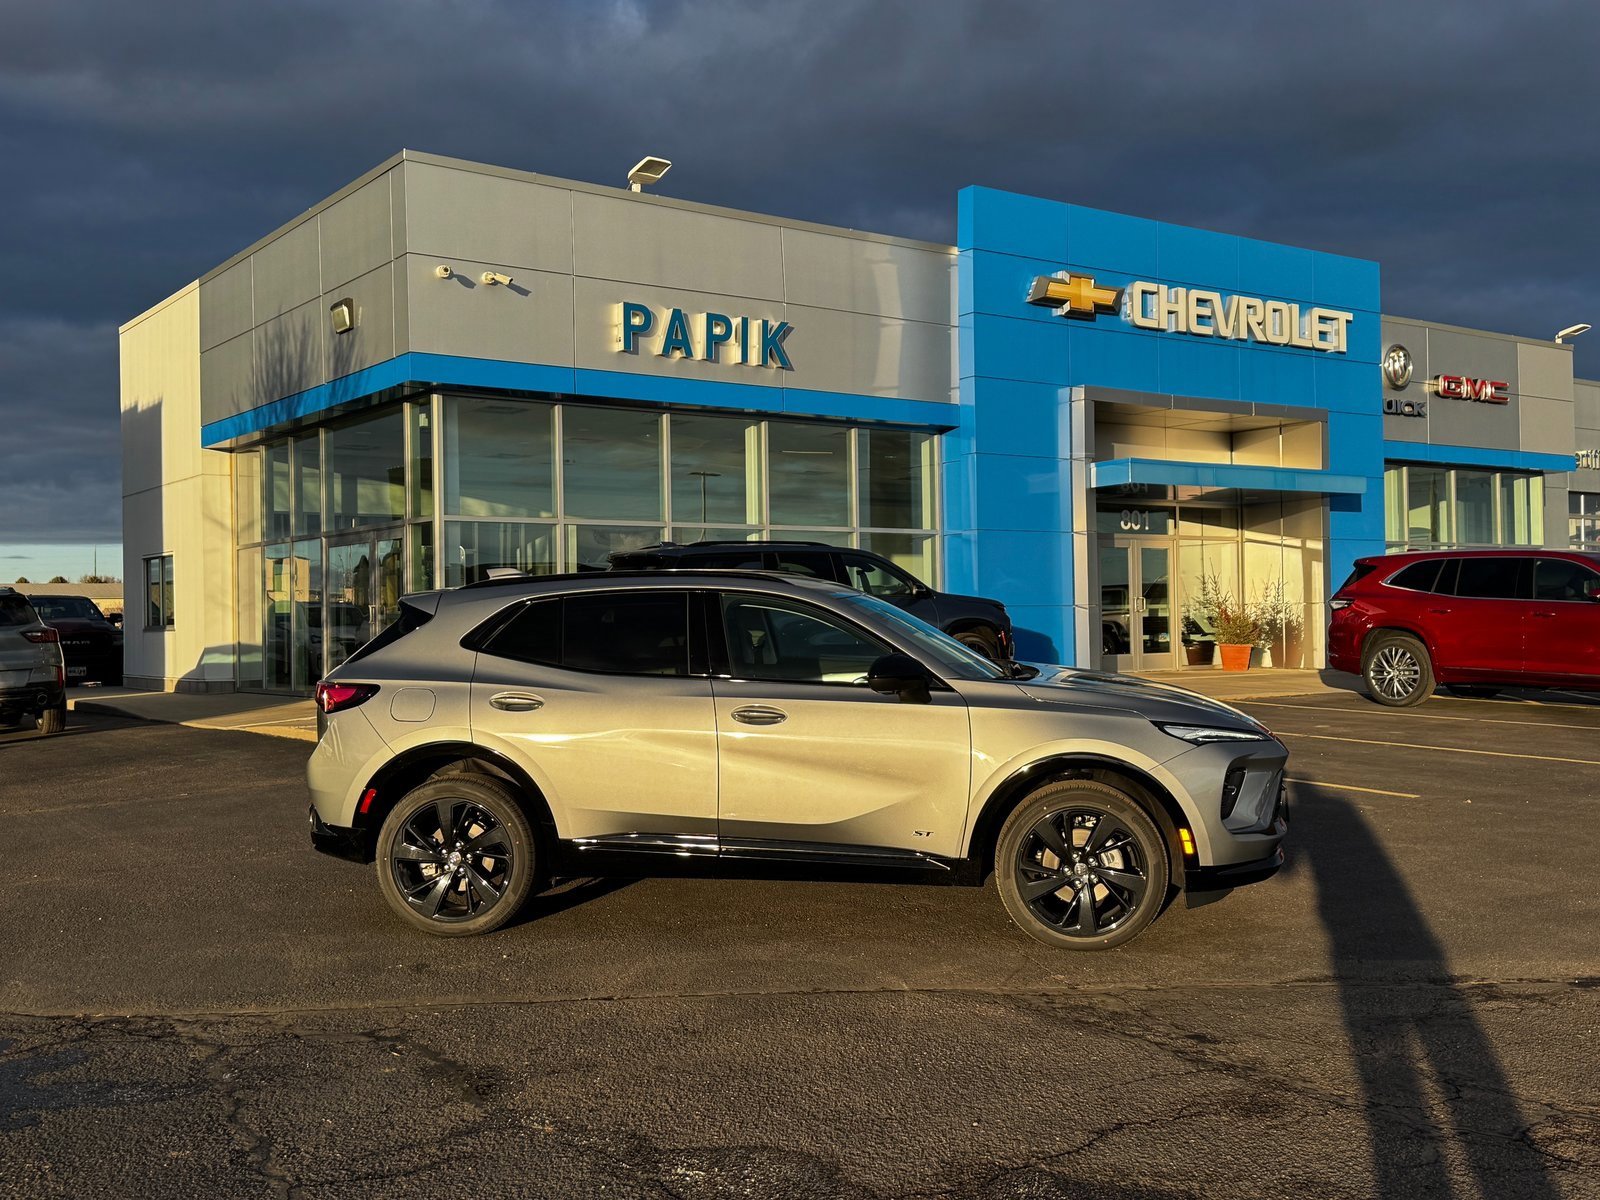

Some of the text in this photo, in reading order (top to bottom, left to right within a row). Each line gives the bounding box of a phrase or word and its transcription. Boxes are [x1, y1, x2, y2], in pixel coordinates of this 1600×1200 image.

[618, 301, 790, 369] PAPIK
[1127, 280, 1353, 353] CHEVROLET
[1437, 375, 1510, 403] GMC
[1120, 509, 1149, 530] 801
